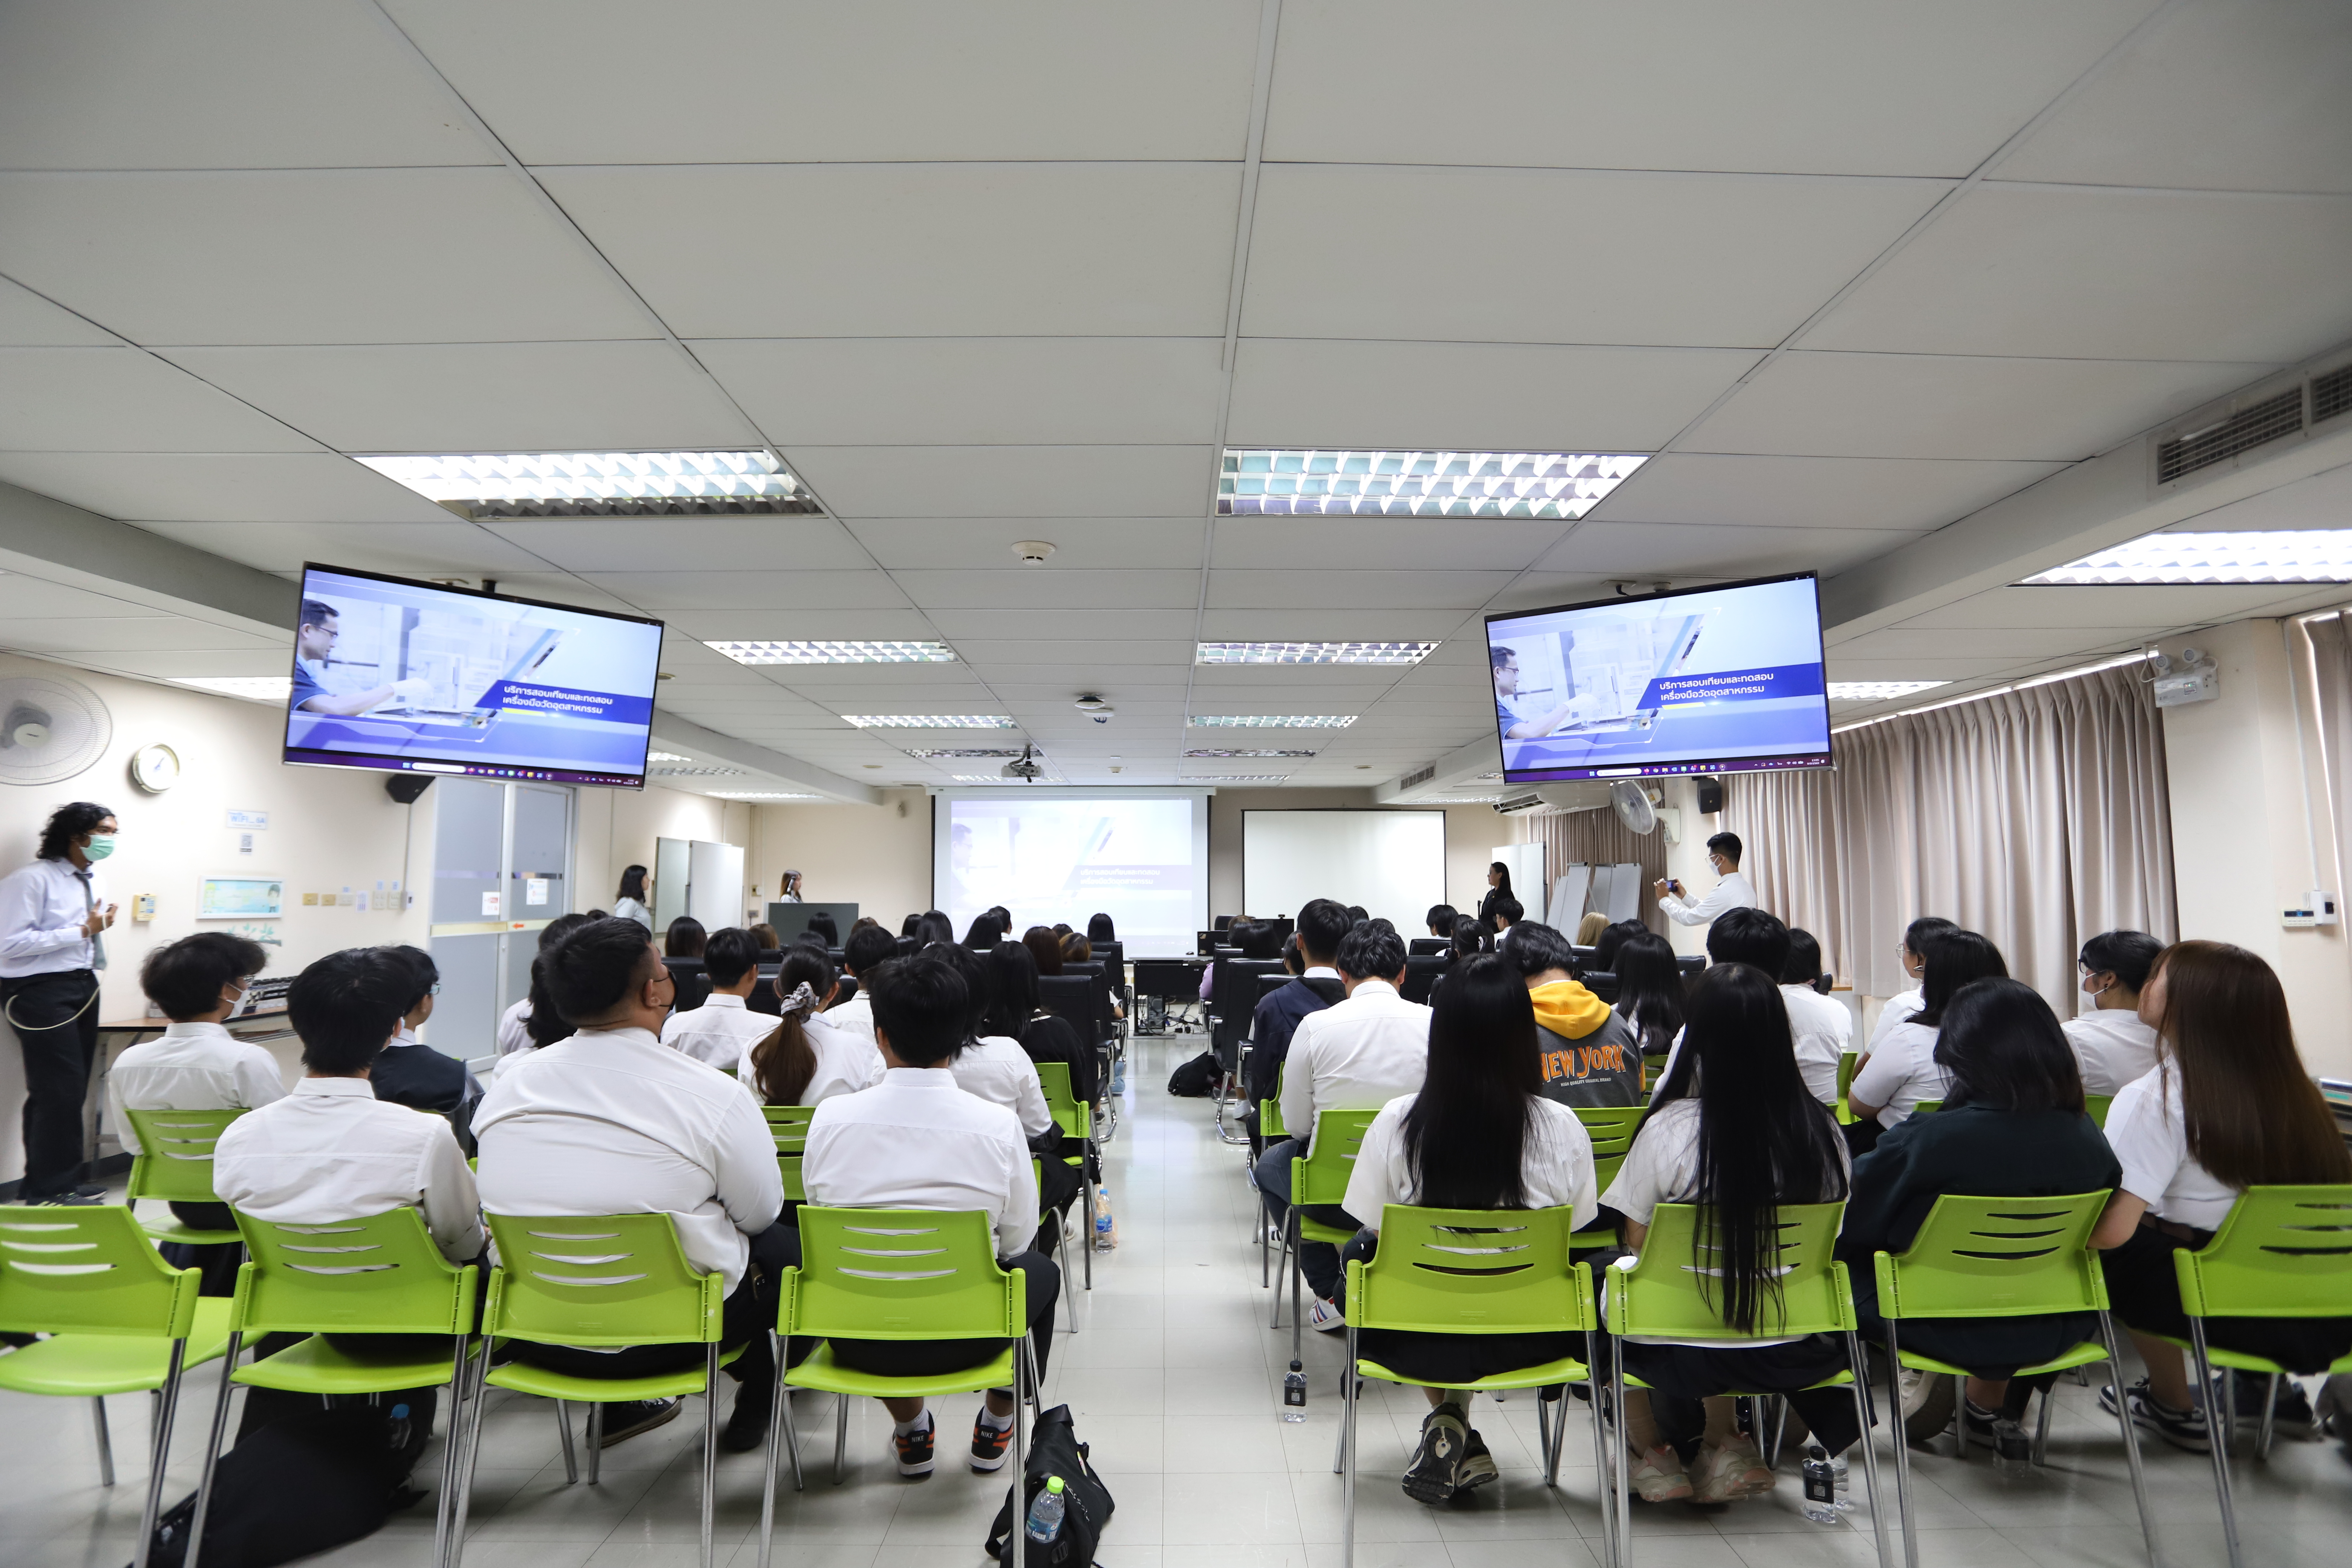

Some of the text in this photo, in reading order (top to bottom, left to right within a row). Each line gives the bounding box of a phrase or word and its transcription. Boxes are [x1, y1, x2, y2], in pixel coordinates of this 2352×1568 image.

[1659, 672, 1774, 690] บริการสอบเทียบและทดสอบ
[504, 685, 613, 705] บริการสอบเทียบและทดสอบ
[1660, 685, 1765, 701] เครื่องมือวัดอุตสาหกรรม
[502, 695, 603, 714] เครื่องมือวัดอุตสาหกรรม
[1577, 1045, 1626, 1079] YORK
